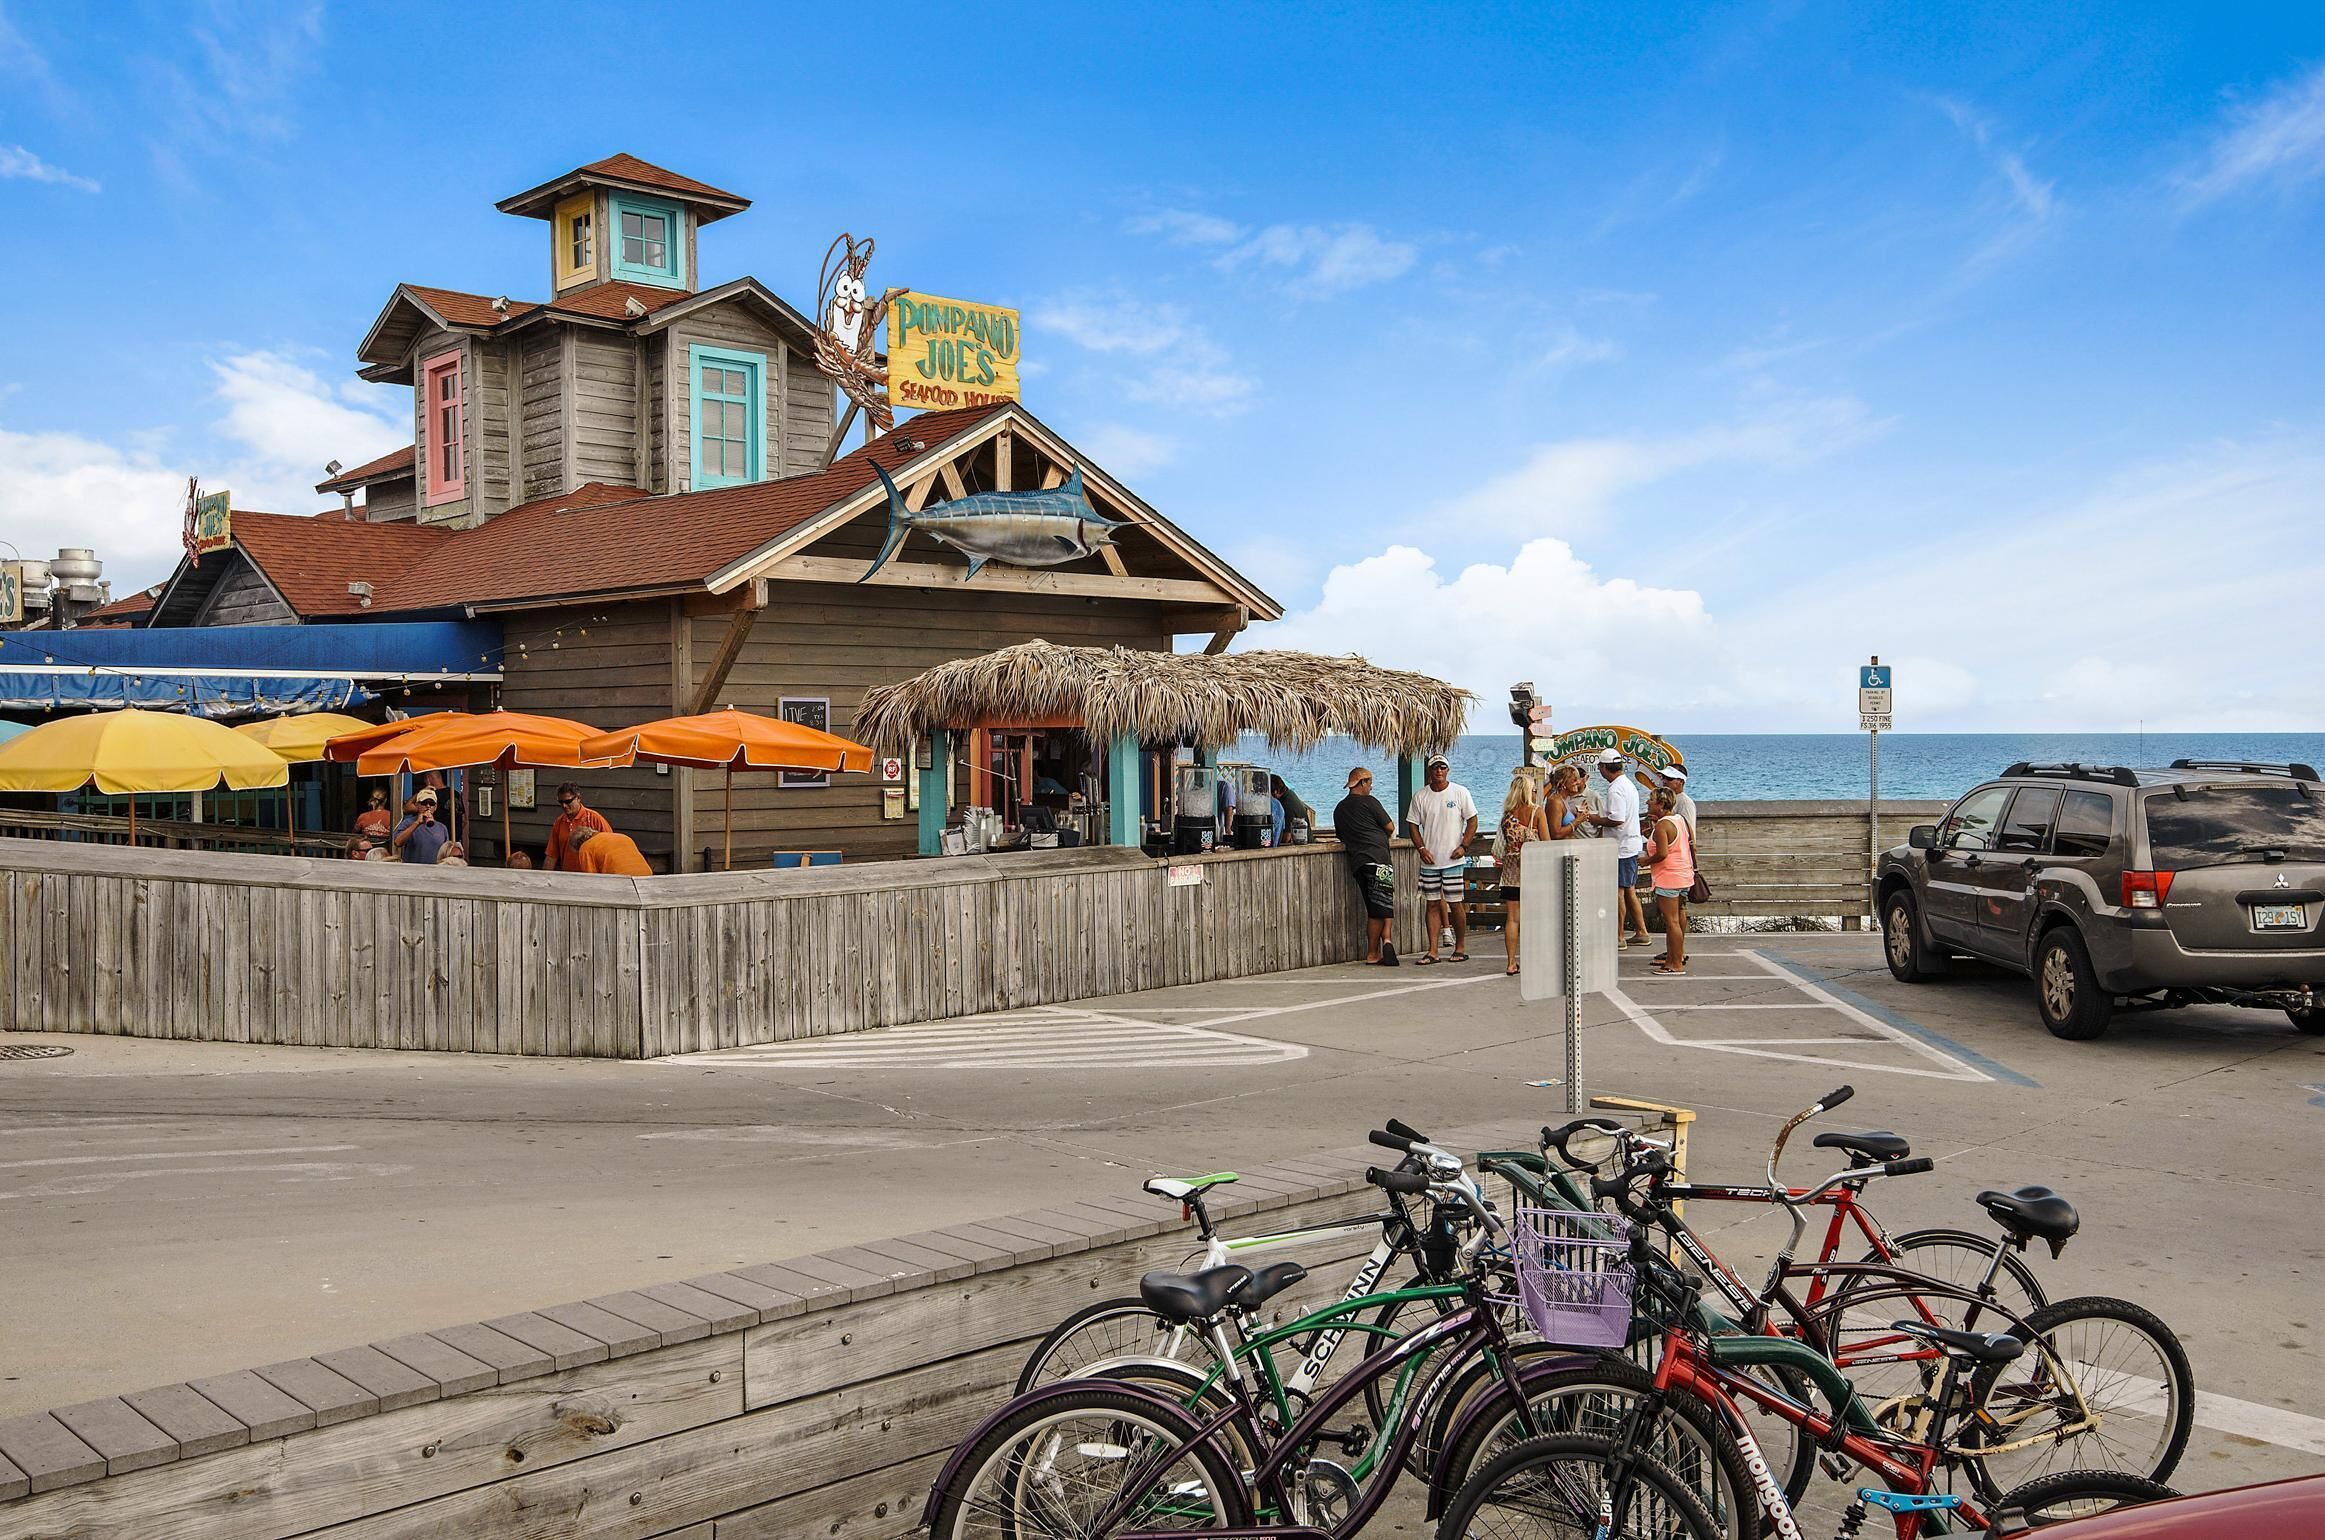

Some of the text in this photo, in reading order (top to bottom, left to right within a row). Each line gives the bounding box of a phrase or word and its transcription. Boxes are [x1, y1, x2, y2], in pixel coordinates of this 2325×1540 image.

[896, 298, 1015, 359] POMPANO
[915, 339, 996, 386] JOE'S
[900, 379, 959, 407] SEAFOOD
[1543, 728, 1671, 771] OMPANO JOE'S
[1178, 867, 1191, 876] NO
